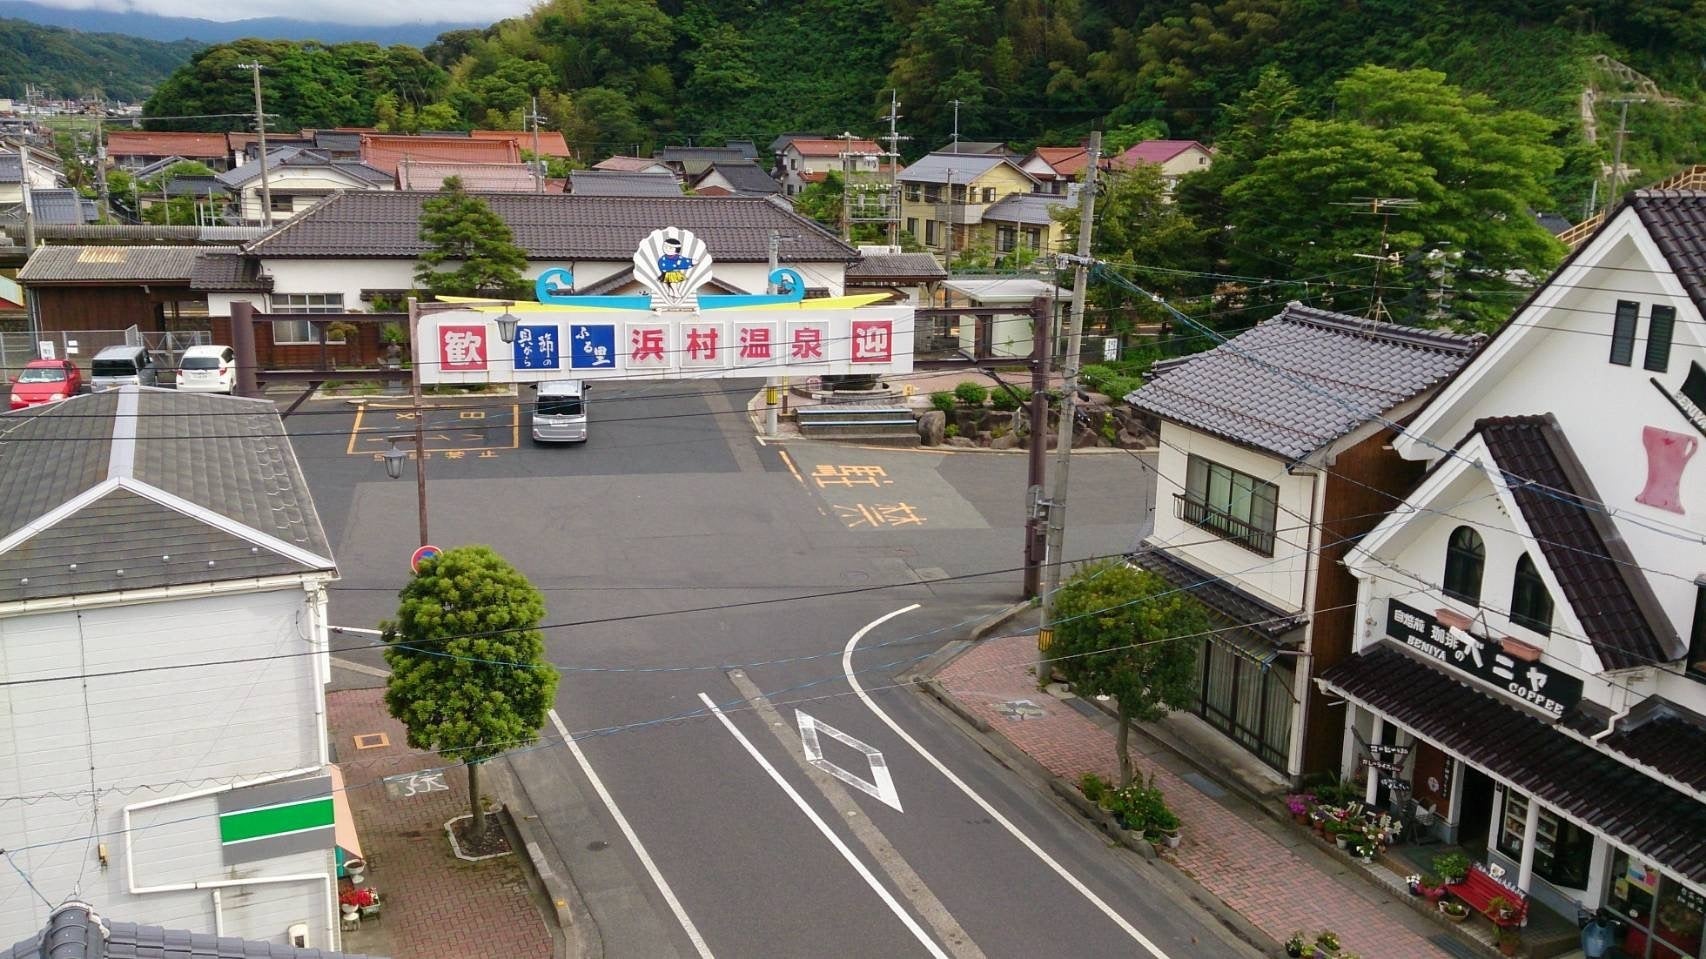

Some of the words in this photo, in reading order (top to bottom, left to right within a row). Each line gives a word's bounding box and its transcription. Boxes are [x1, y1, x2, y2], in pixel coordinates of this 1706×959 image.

[444, 330, 483, 366] 歓
[631, 326, 823, 361] 浜村温泉
[856, 325, 889, 360] 迎
[1407, 634, 1447, 661] BENIYA
[1508, 681, 1566, 716] COFFEE
